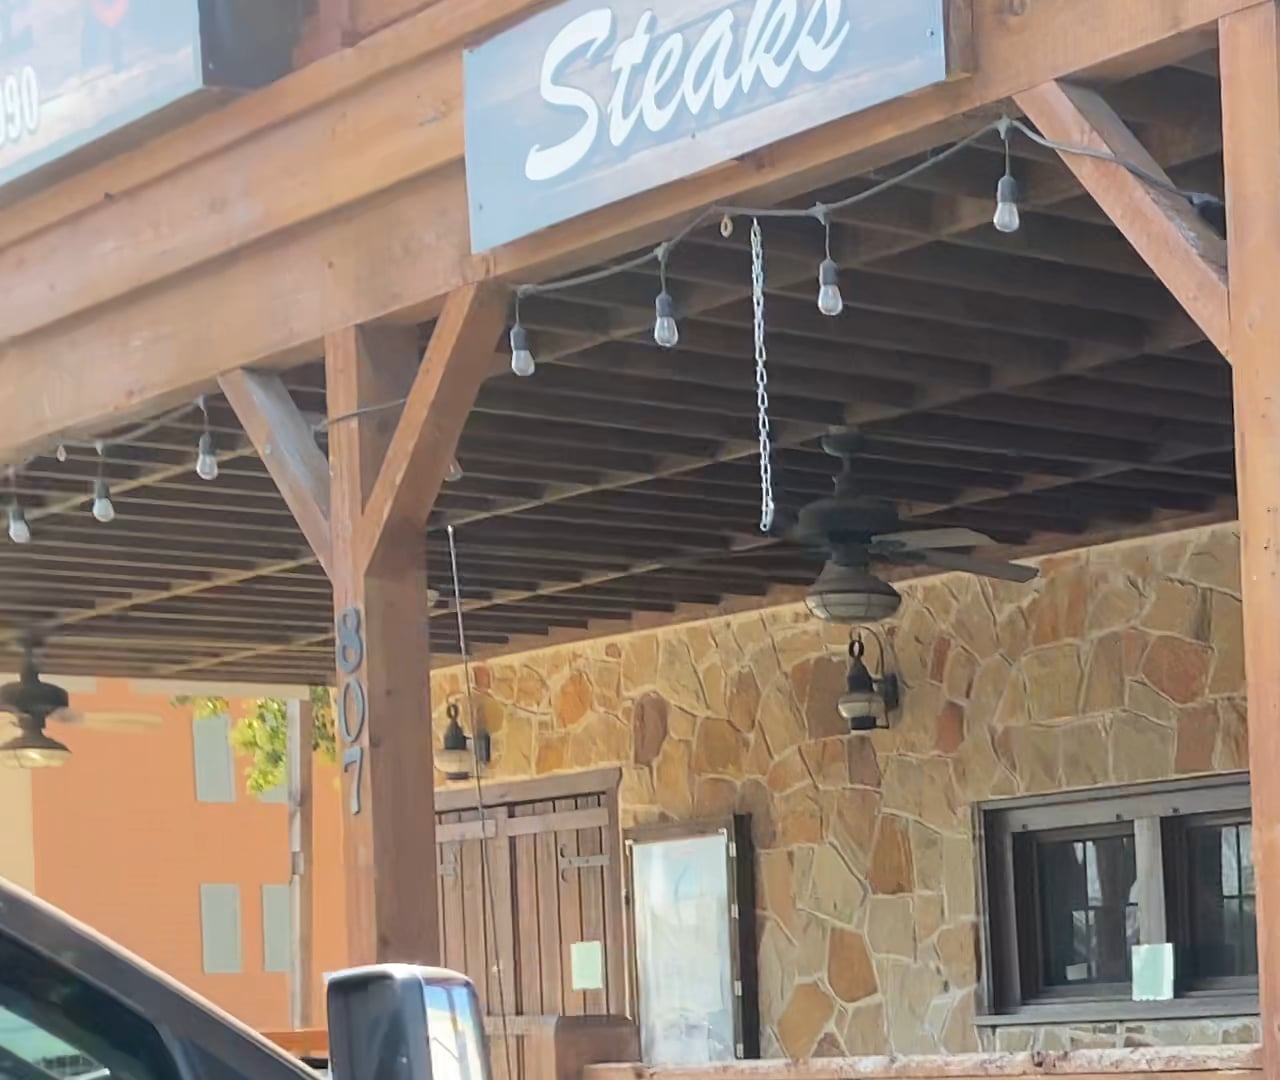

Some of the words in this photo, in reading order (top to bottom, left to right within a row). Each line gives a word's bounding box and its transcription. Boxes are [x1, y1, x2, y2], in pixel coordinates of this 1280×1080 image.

[0, 65, 39, 147] 90
[525, 0, 849, 181] Steaks
[335, 606, 366, 815] 807
